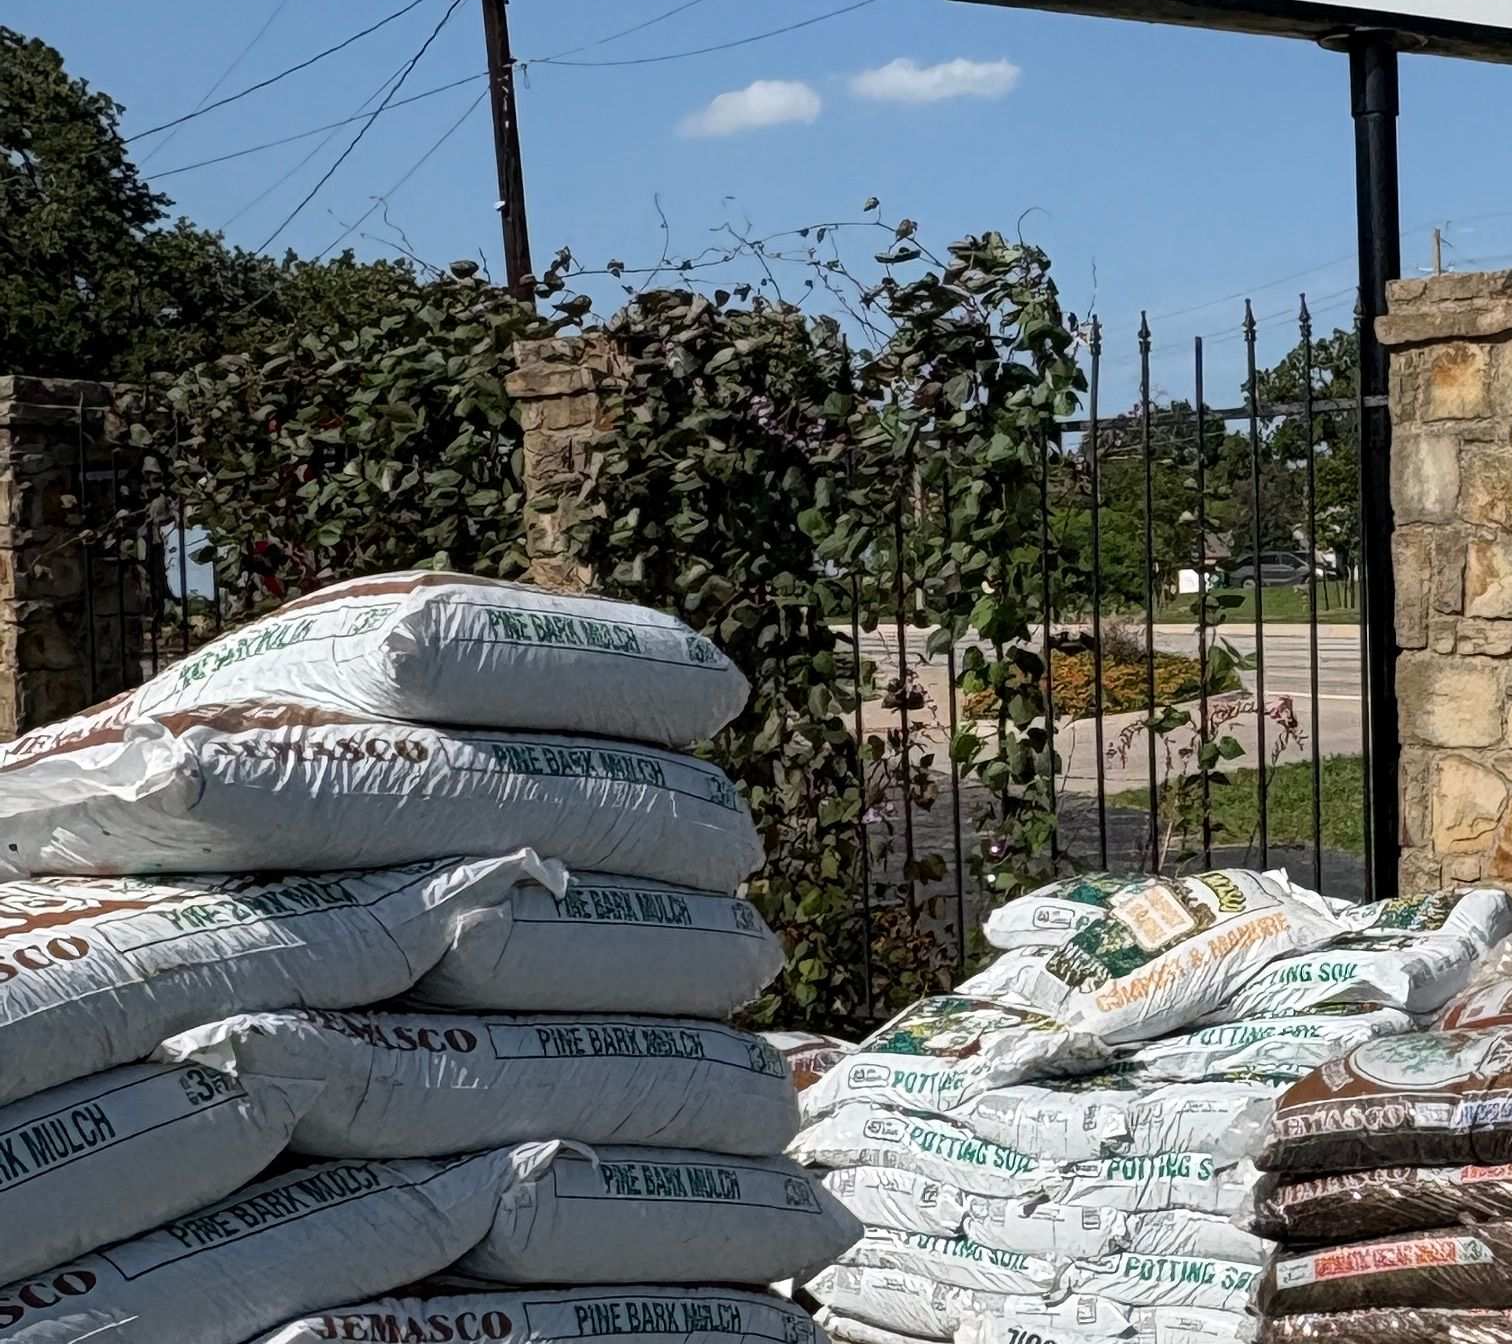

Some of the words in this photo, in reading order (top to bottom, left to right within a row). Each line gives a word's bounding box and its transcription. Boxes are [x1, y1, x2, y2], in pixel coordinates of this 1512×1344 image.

[487, 608, 533, 641] PINE
[1317, 961, 1359, 984] SOIL
[537, 1028, 589, 1057] PINE
[592, 1027, 642, 1056] BARK
[20, 1102, 117, 1169] MULCH
[908, 1125, 988, 1166] POTTING
[995, 1146, 1041, 1175] SOIL
[602, 1166, 644, 1197] PINE
[645, 1167, 687, 1198] BARK
[1107, 1157, 1191, 1181] POTTING
[167, 1211, 240, 1249] PINE
[237, 1184, 305, 1228] BARK
[1123, 1256, 1216, 1285] POTTING
[318, 1309, 513, 1344] JEMASCO
[574, 1302, 624, 1336] PINE
[627, 1301, 680, 1334] BARK
